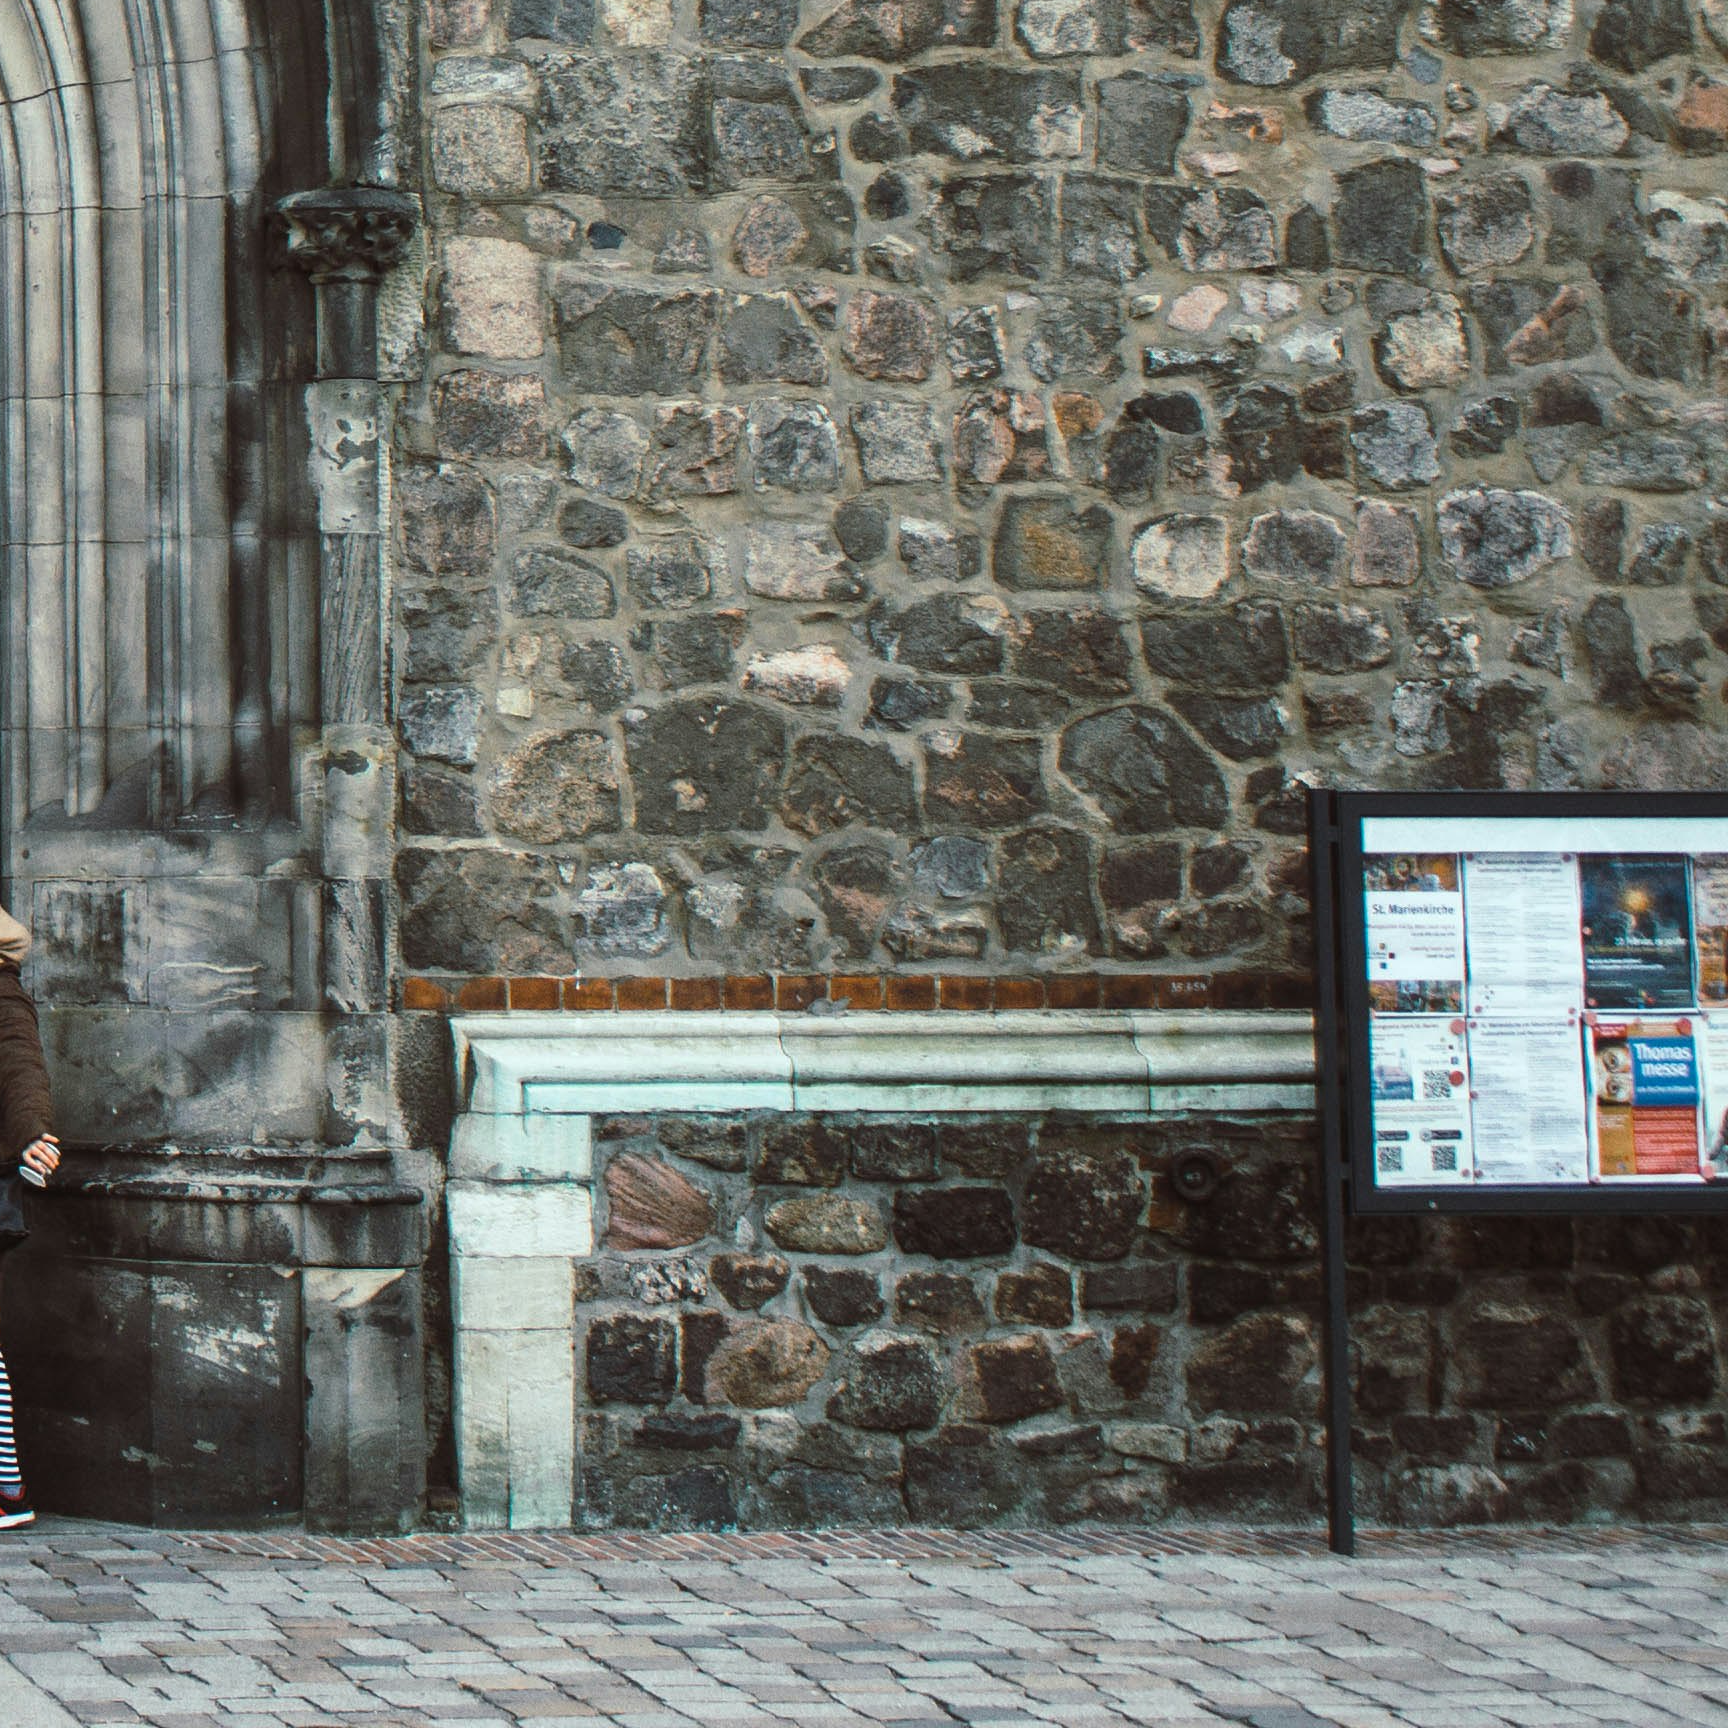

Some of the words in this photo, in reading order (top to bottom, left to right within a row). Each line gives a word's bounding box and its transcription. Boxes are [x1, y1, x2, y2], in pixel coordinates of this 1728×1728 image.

[1388, 904, 1454, 915] Marienkirche
[1633, 1043, 1692, 1061] Thomas
[1641, 1062, 1689, 1077] messe
